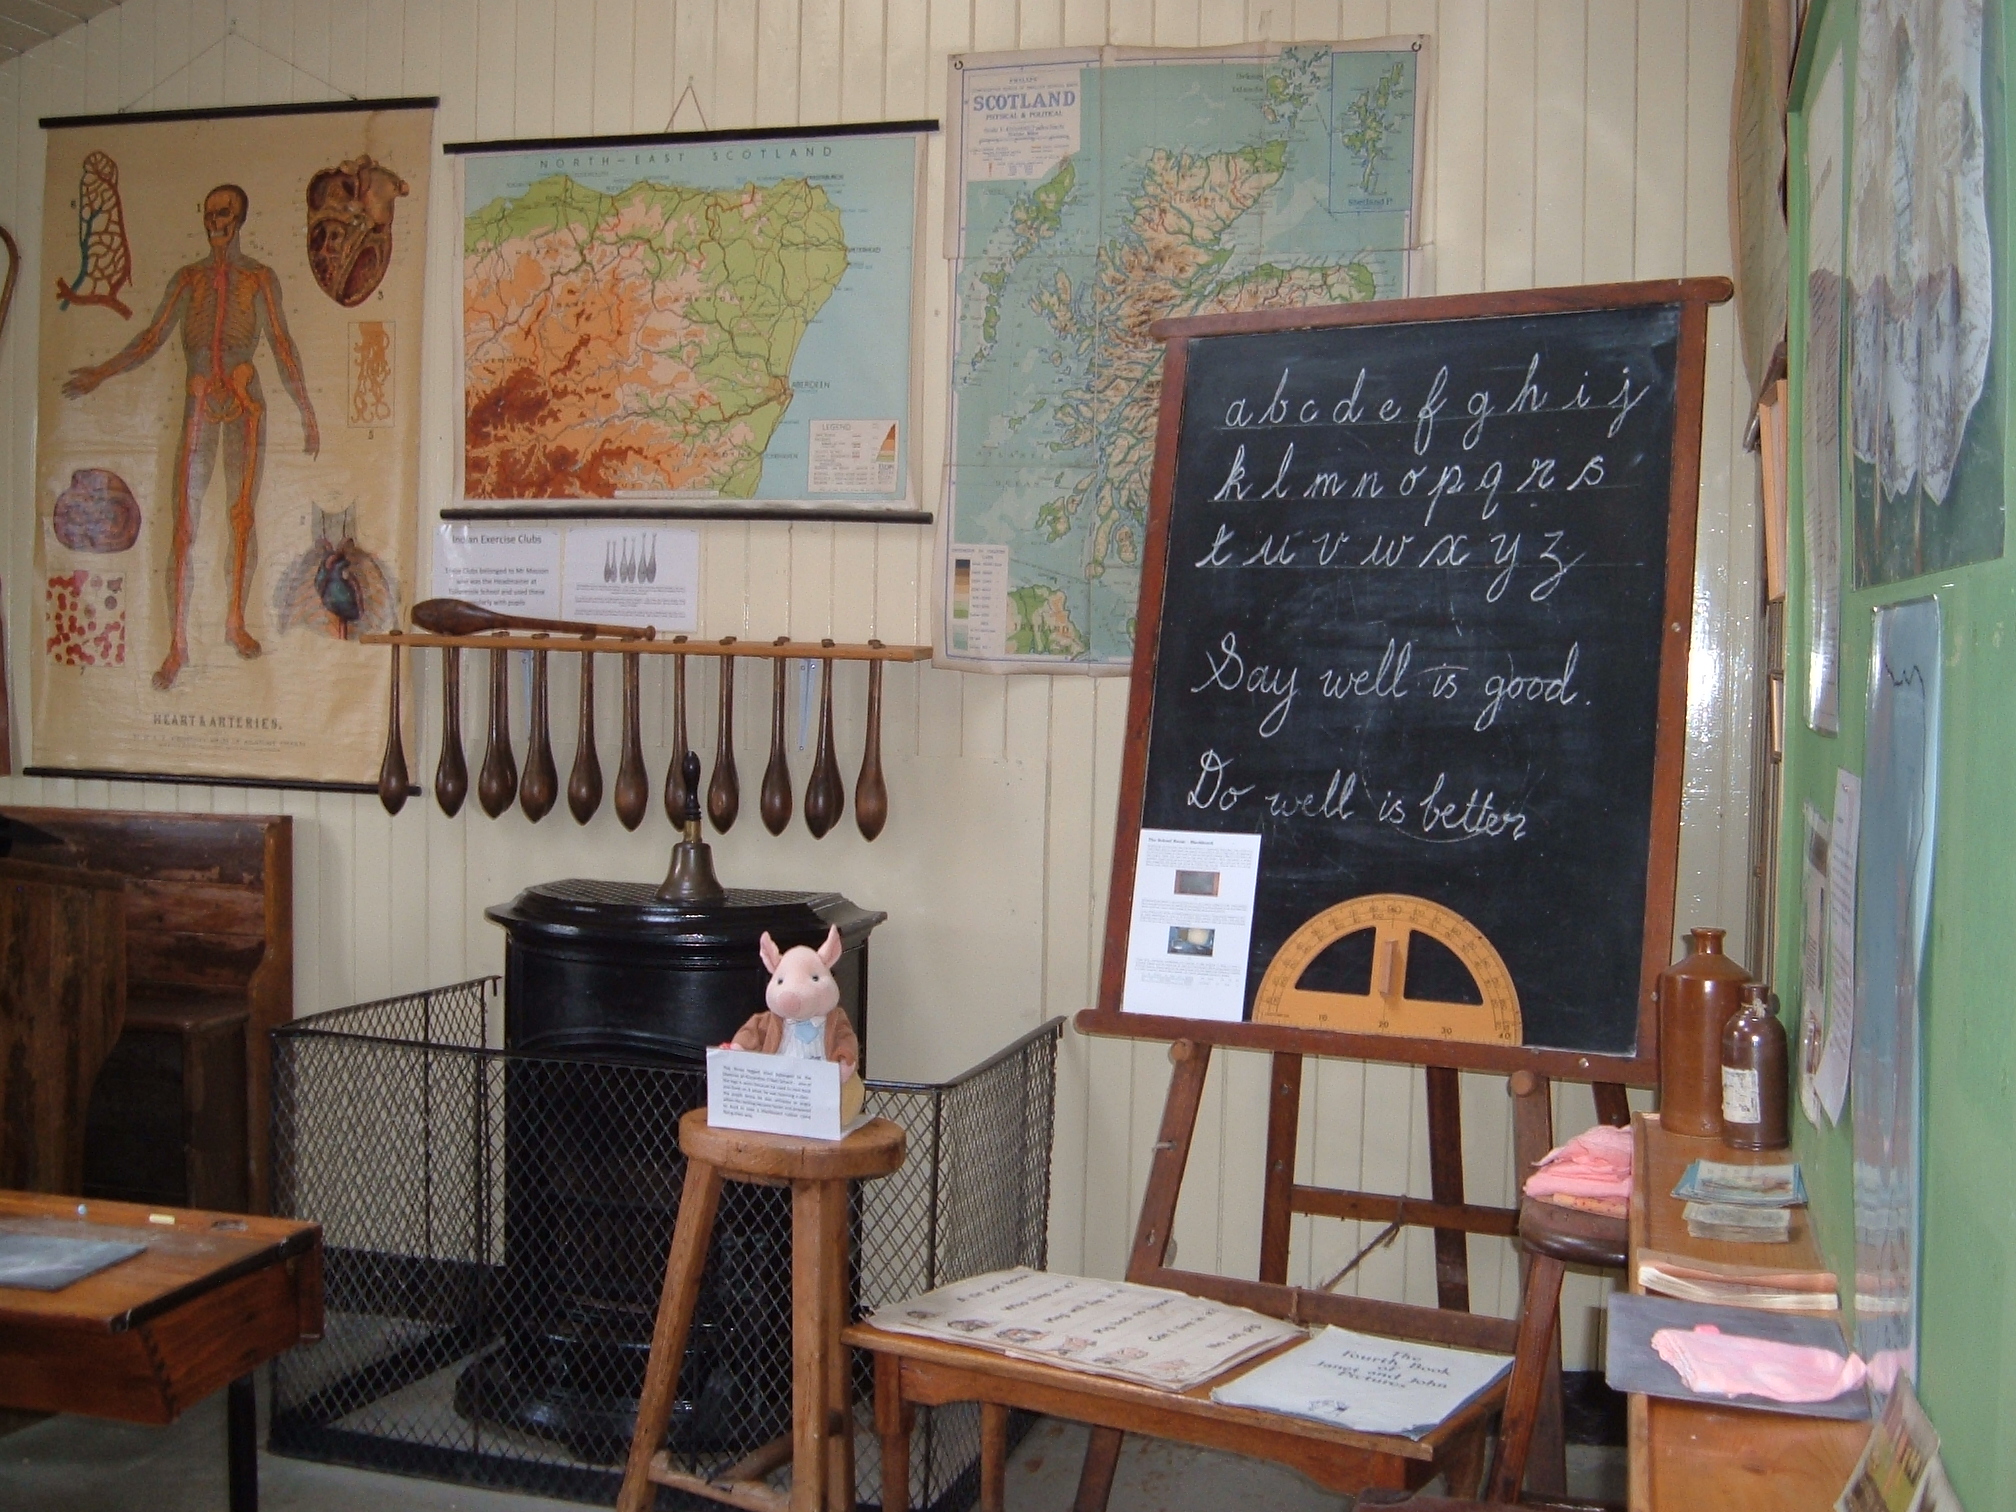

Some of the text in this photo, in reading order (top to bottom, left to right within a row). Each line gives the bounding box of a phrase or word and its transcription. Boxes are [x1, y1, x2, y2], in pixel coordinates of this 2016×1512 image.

[973, 90, 1076, 112] SCOTLAND
[1029, 110, 1062, 118] POLITICAL
[712, 146, 833, 162] SCOTLAND
[1225, 353, 1650, 456] a b c d e f g h i j
[822, 423, 852, 431] LEGEND
[1213, 442, 1605, 527] k l m n o p q r s
[480, 534, 516, 544] Exercise
[518, 533, 542, 544] Clubs
[1194, 523, 1586, 603] t u v w x y z
[1190, 631, 1593, 738] Say well is good.
[153, 713, 196, 727] HEART
[1186, 748, 1528, 842] Do well is better
[1441, 1027, 1452, 1035] 30
[1342, 1350, 1398, 1366] Fourth
[1367, 1371, 1402, 1380] and
[1409, 1377, 1448, 1389] John
